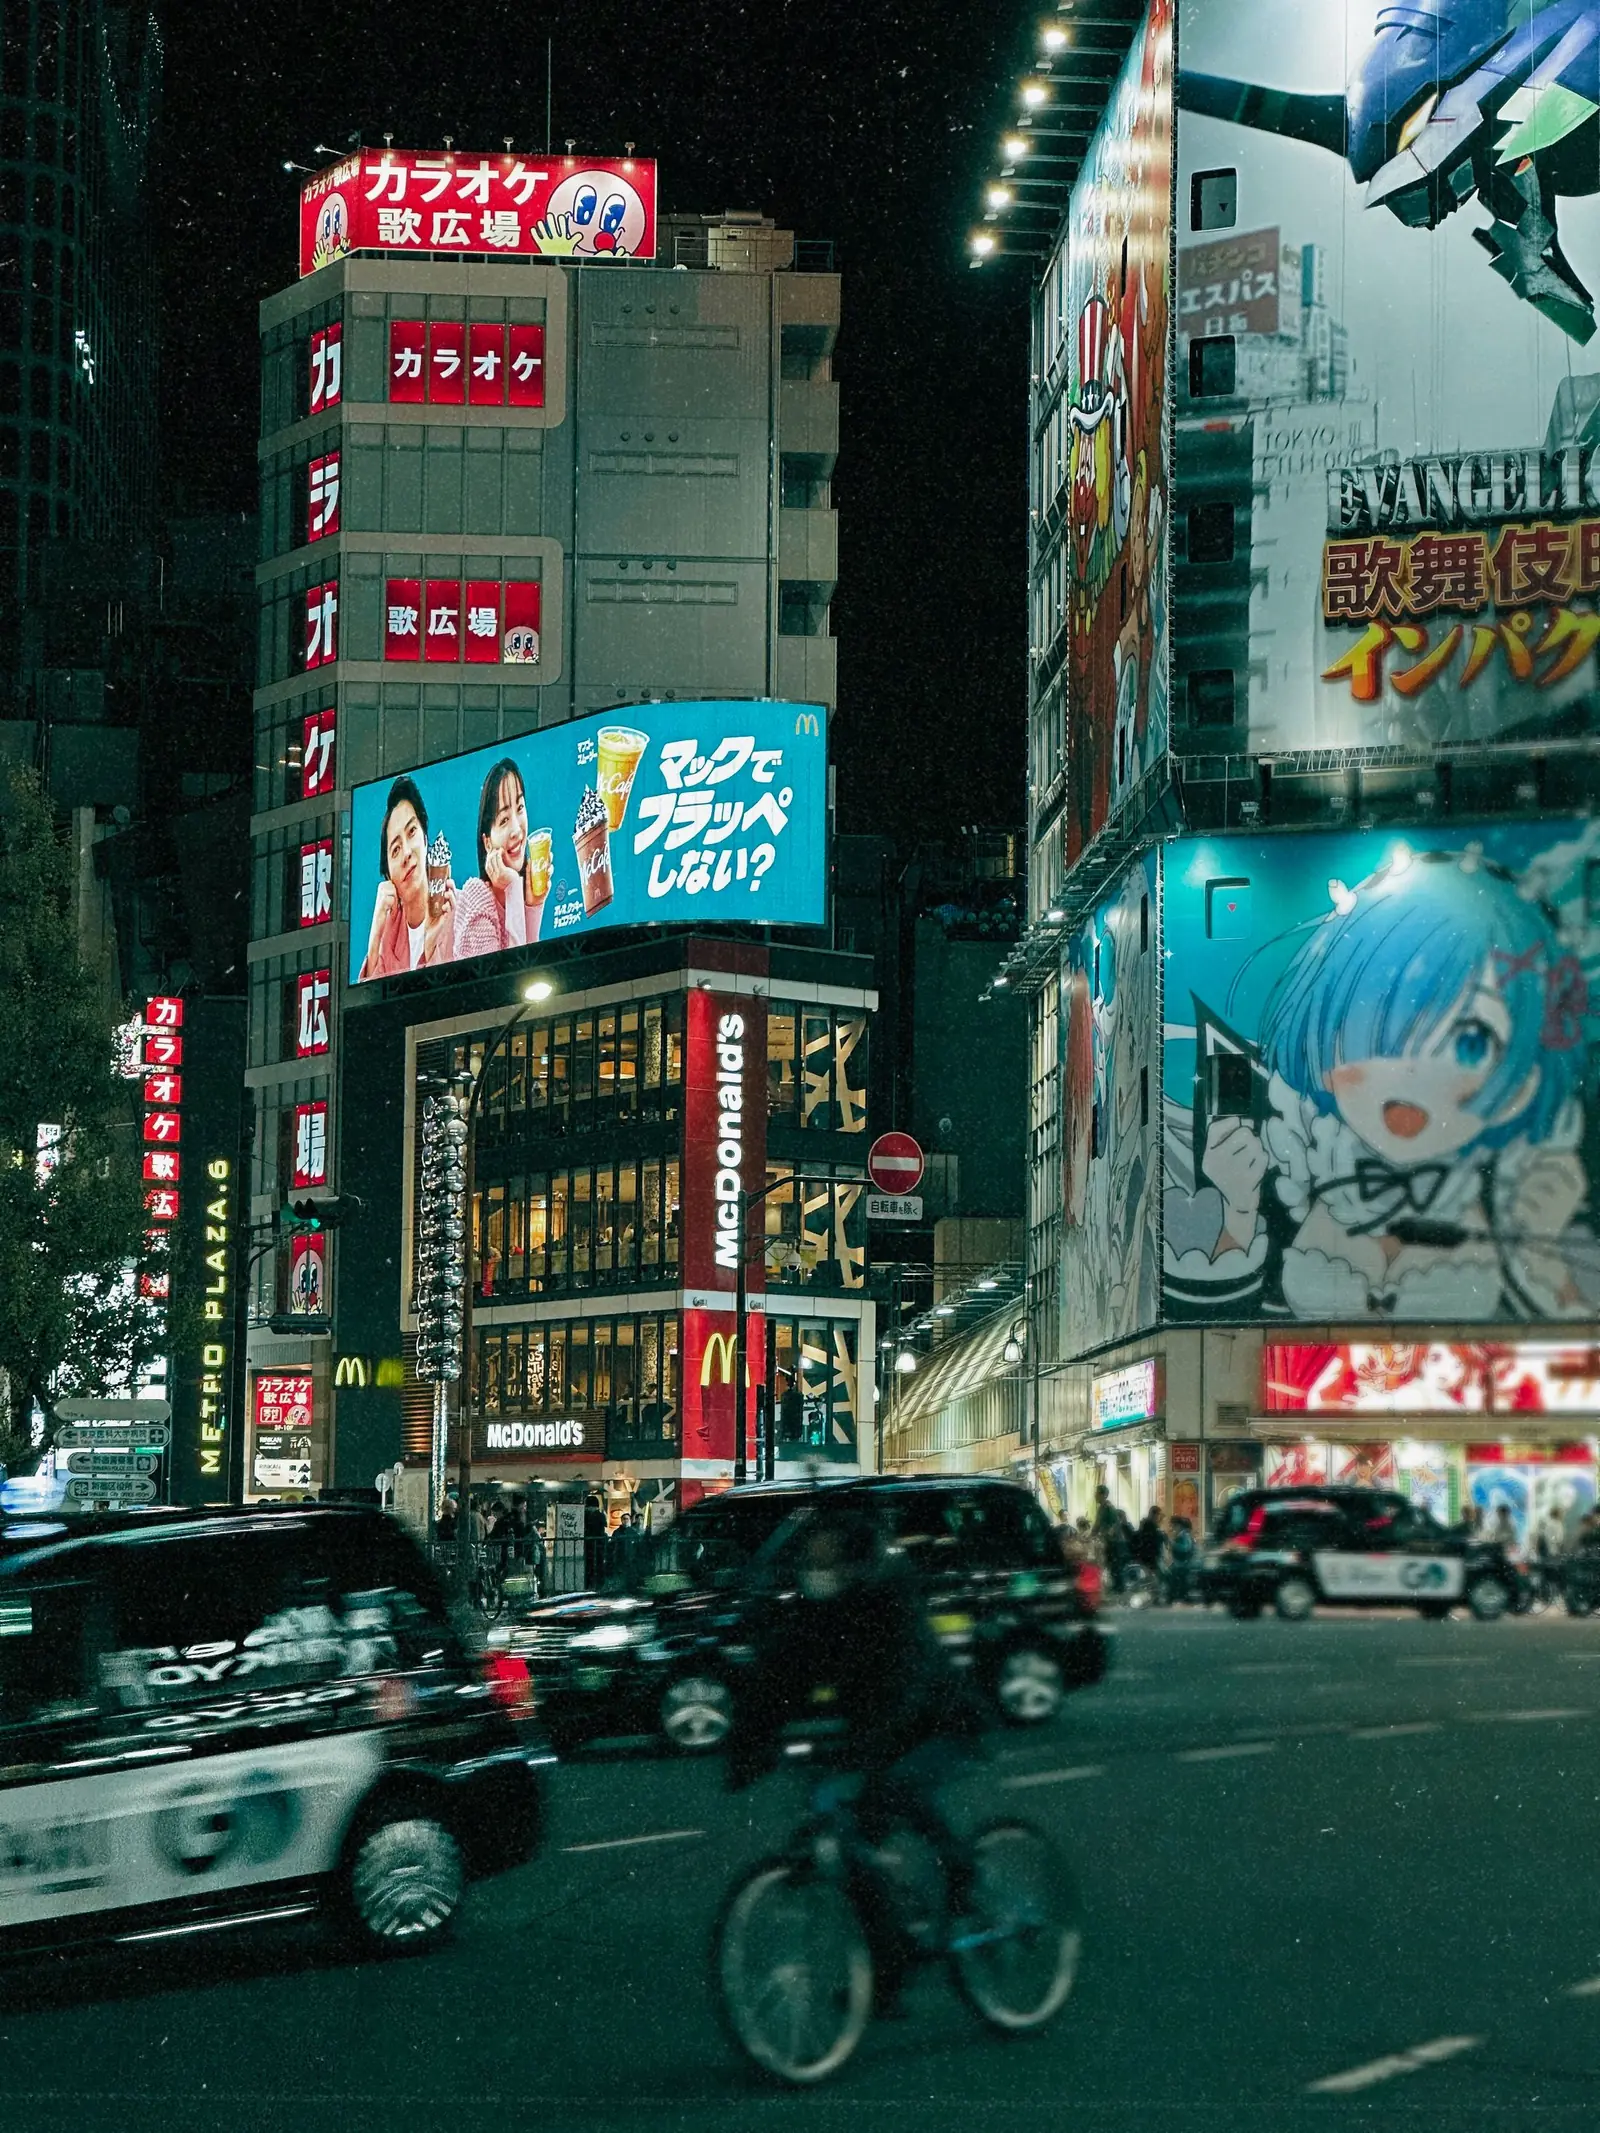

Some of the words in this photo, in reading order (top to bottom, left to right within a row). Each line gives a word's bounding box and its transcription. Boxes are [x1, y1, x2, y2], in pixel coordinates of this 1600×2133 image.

[364, 157, 548, 206] カラオケ
[377, 208, 521, 248] 歌広場
[1179, 269, 1279, 314] エスパス
[394, 347, 541, 382] カラオケ
[387, 605, 498, 638] 歌広場
[660, 736, 783, 790] マックで
[634, 786, 793, 855] フラッペ
[715, 1013, 745, 1269] McDonald's
[871, 1201, 918, 1216] 自転車を除く
[258, 1379, 312, 1392] カラオケ
[263, 1392, 307, 1404] 歌広場
[487, 1420, 584, 1448] McDonald's
